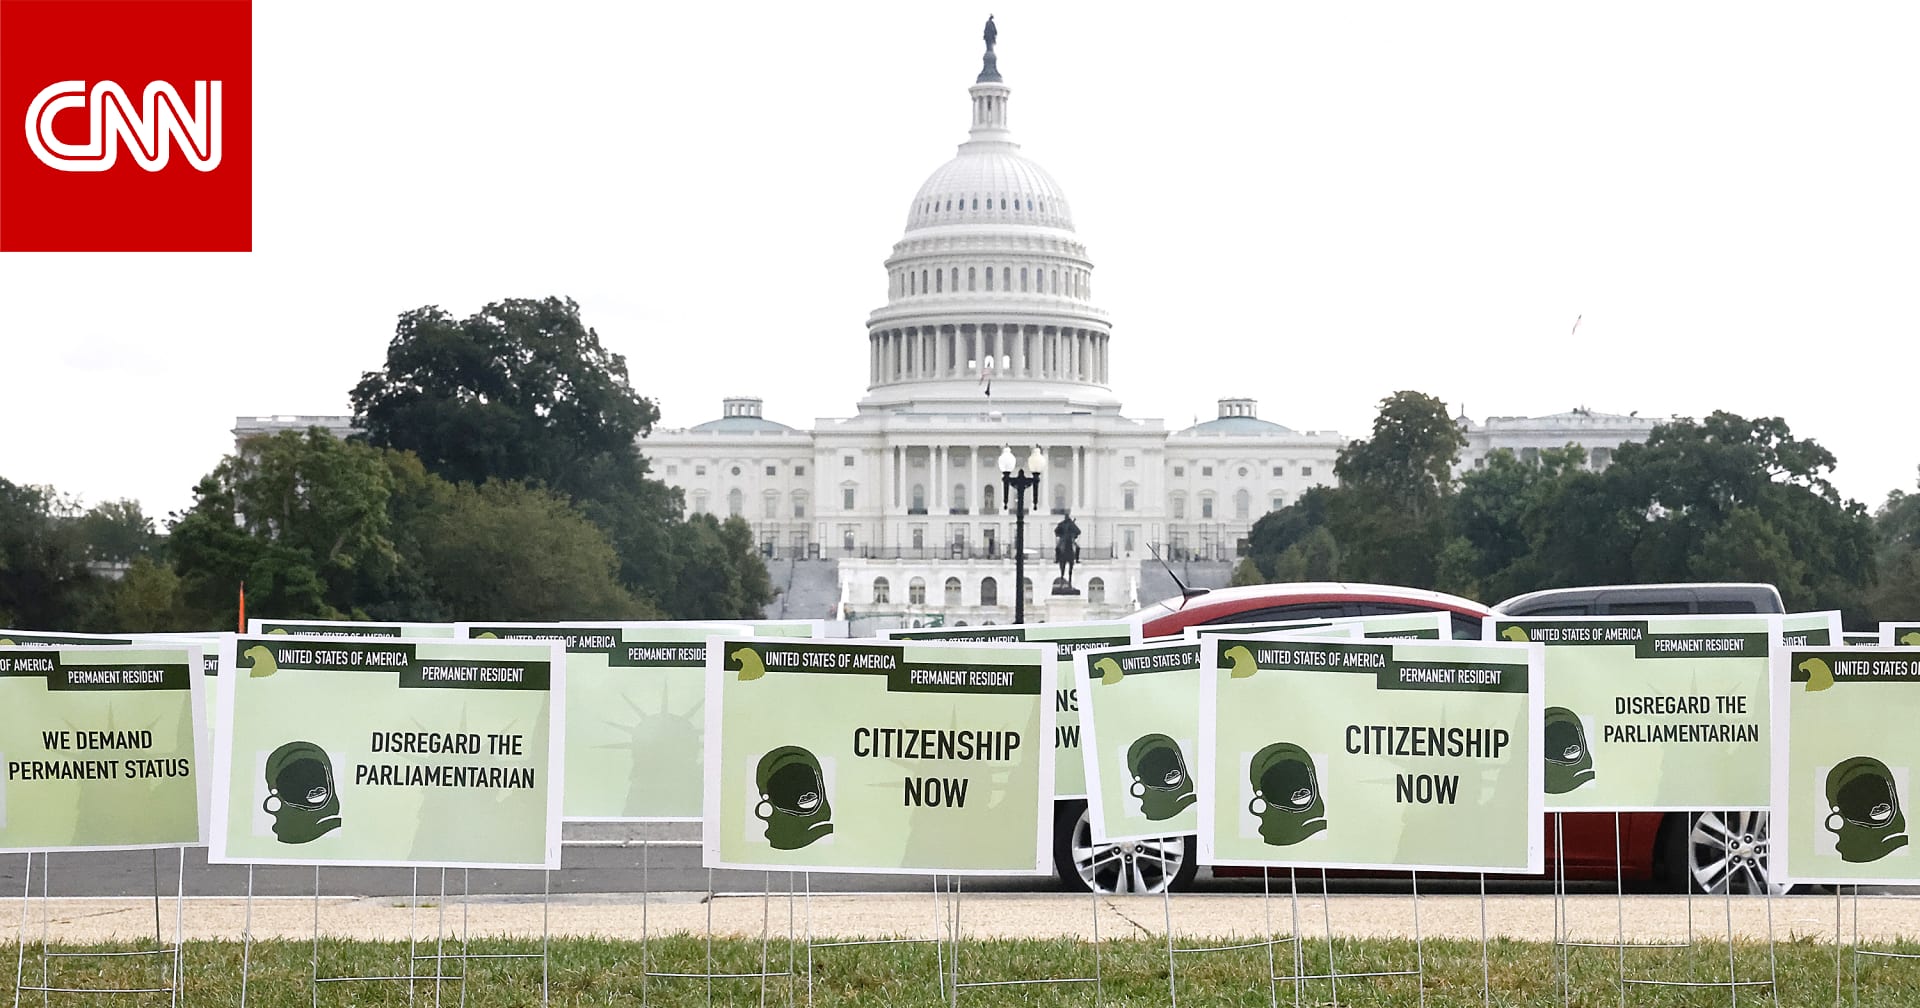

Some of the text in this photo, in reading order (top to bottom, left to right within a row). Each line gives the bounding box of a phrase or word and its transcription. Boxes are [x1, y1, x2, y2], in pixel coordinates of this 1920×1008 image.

[566, 636, 577, 648] OF
[579, 636, 616, 648] AMERICA
[1530, 628, 1642, 641] UNITED STATES OF AMERICA
[1782, 636, 1807, 646] SIDENT
[1654, 638, 1745, 652] PERMANENT RESIDENT
[278, 649, 409, 667] UNITED STATES OF AMERICA
[628, 648, 706, 661] PERMANENT RESIDE
[765, 651, 896, 669] UNITED STATES OF AMERICA
[1122, 657, 1150, 670] UNITED
[1153, 655, 1180, 668] STATES
[1182, 653, 1193, 665] OF
[1258, 649, 1386, 668] UNITED STATES OF AMERICA
[0, 658, 54, 671] OF AMERICA
[1834, 661, 1870, 676] UNITED
[1873, 661, 1908, 676] STATES
[68, 670, 164, 684] PERMANENT RESIDENT
[422, 667, 524, 682] PERMANENT RESIDENT
[910, 670, 1014, 686] PERMANENT RESIDENT
[1400, 668, 1502, 685] PERMANENT RESIDENT
[1615, 696, 1747, 715] DISREGARD THE
[42, 730, 153, 750] WE DEMAND
[1345, 725, 1510, 758] CITIZENSHIP
[1604, 724, 1759, 743] PARLIAMENTARIAN
[371, 731, 523, 755] DISREGARD THE
[854, 727, 1021, 761] CITIZENSHIP
[8, 758, 190, 780] PERMANENT STATUS
[355, 764, 535, 789] PARLIAMENTARIAN
[904, 777, 969, 808] NOW
[1396, 774, 1459, 804] NOW
